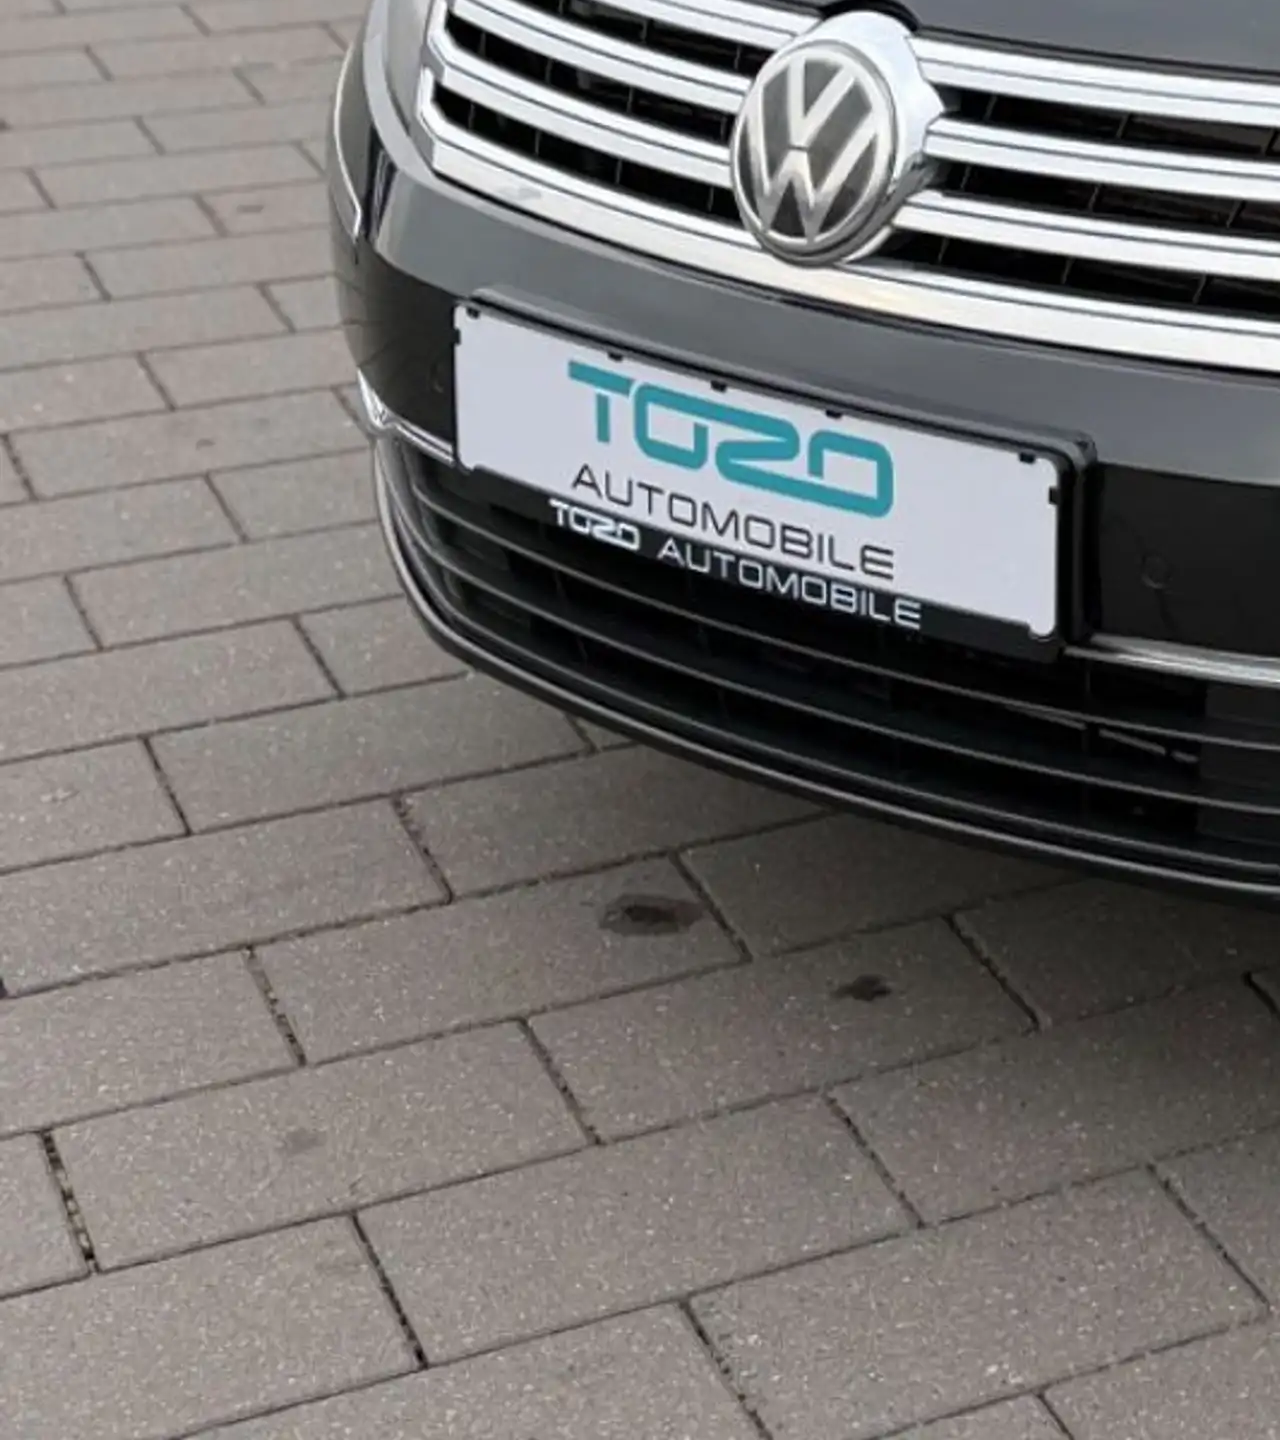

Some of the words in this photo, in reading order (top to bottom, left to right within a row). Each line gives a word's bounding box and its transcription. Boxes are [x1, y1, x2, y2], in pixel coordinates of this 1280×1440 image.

[742, 45, 884, 248] VW
[572, 463, 895, 581] AUTOMOBILE
[656, 537, 922, 630] AUTOMOBILE
